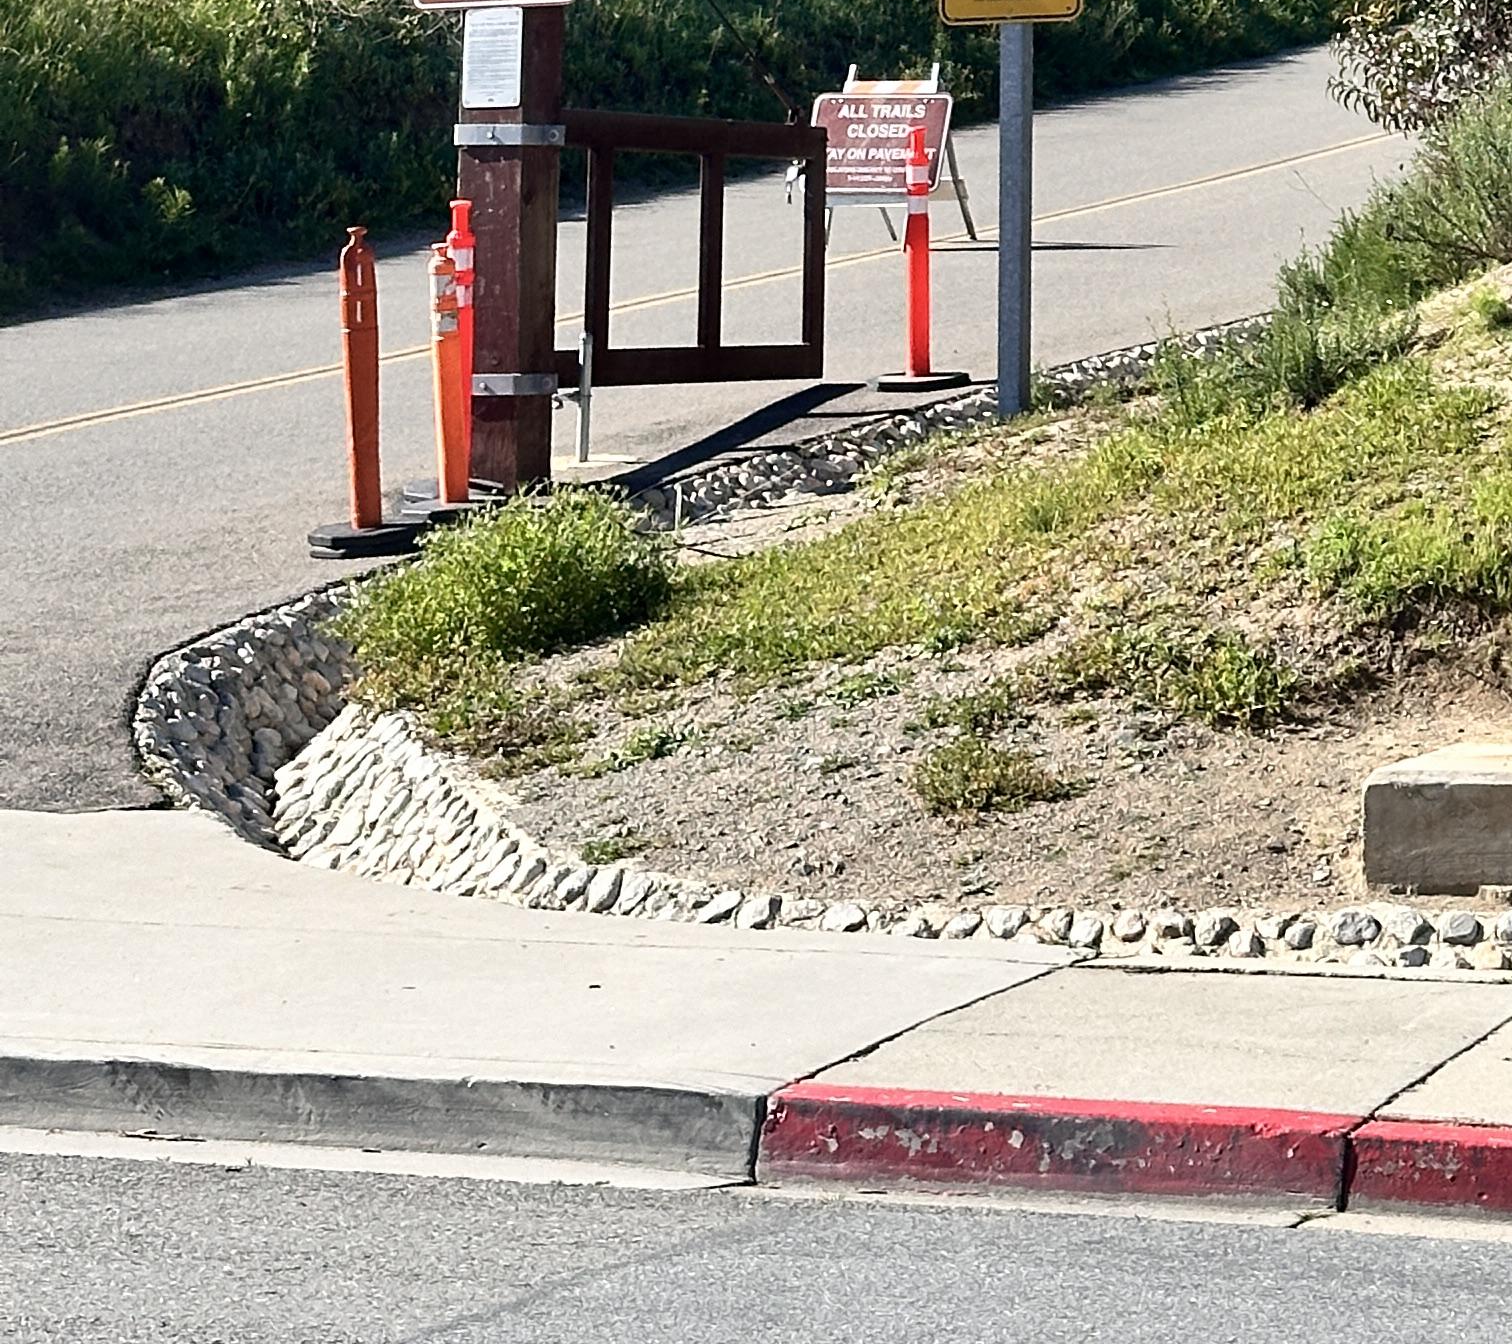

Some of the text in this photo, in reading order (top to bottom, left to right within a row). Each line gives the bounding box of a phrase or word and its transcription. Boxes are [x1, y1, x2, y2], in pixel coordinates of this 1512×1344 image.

[838, 104, 926, 119] ALL TRAILS
[847, 124, 910, 138] CLOSED
[847, 147, 866, 160] ON
